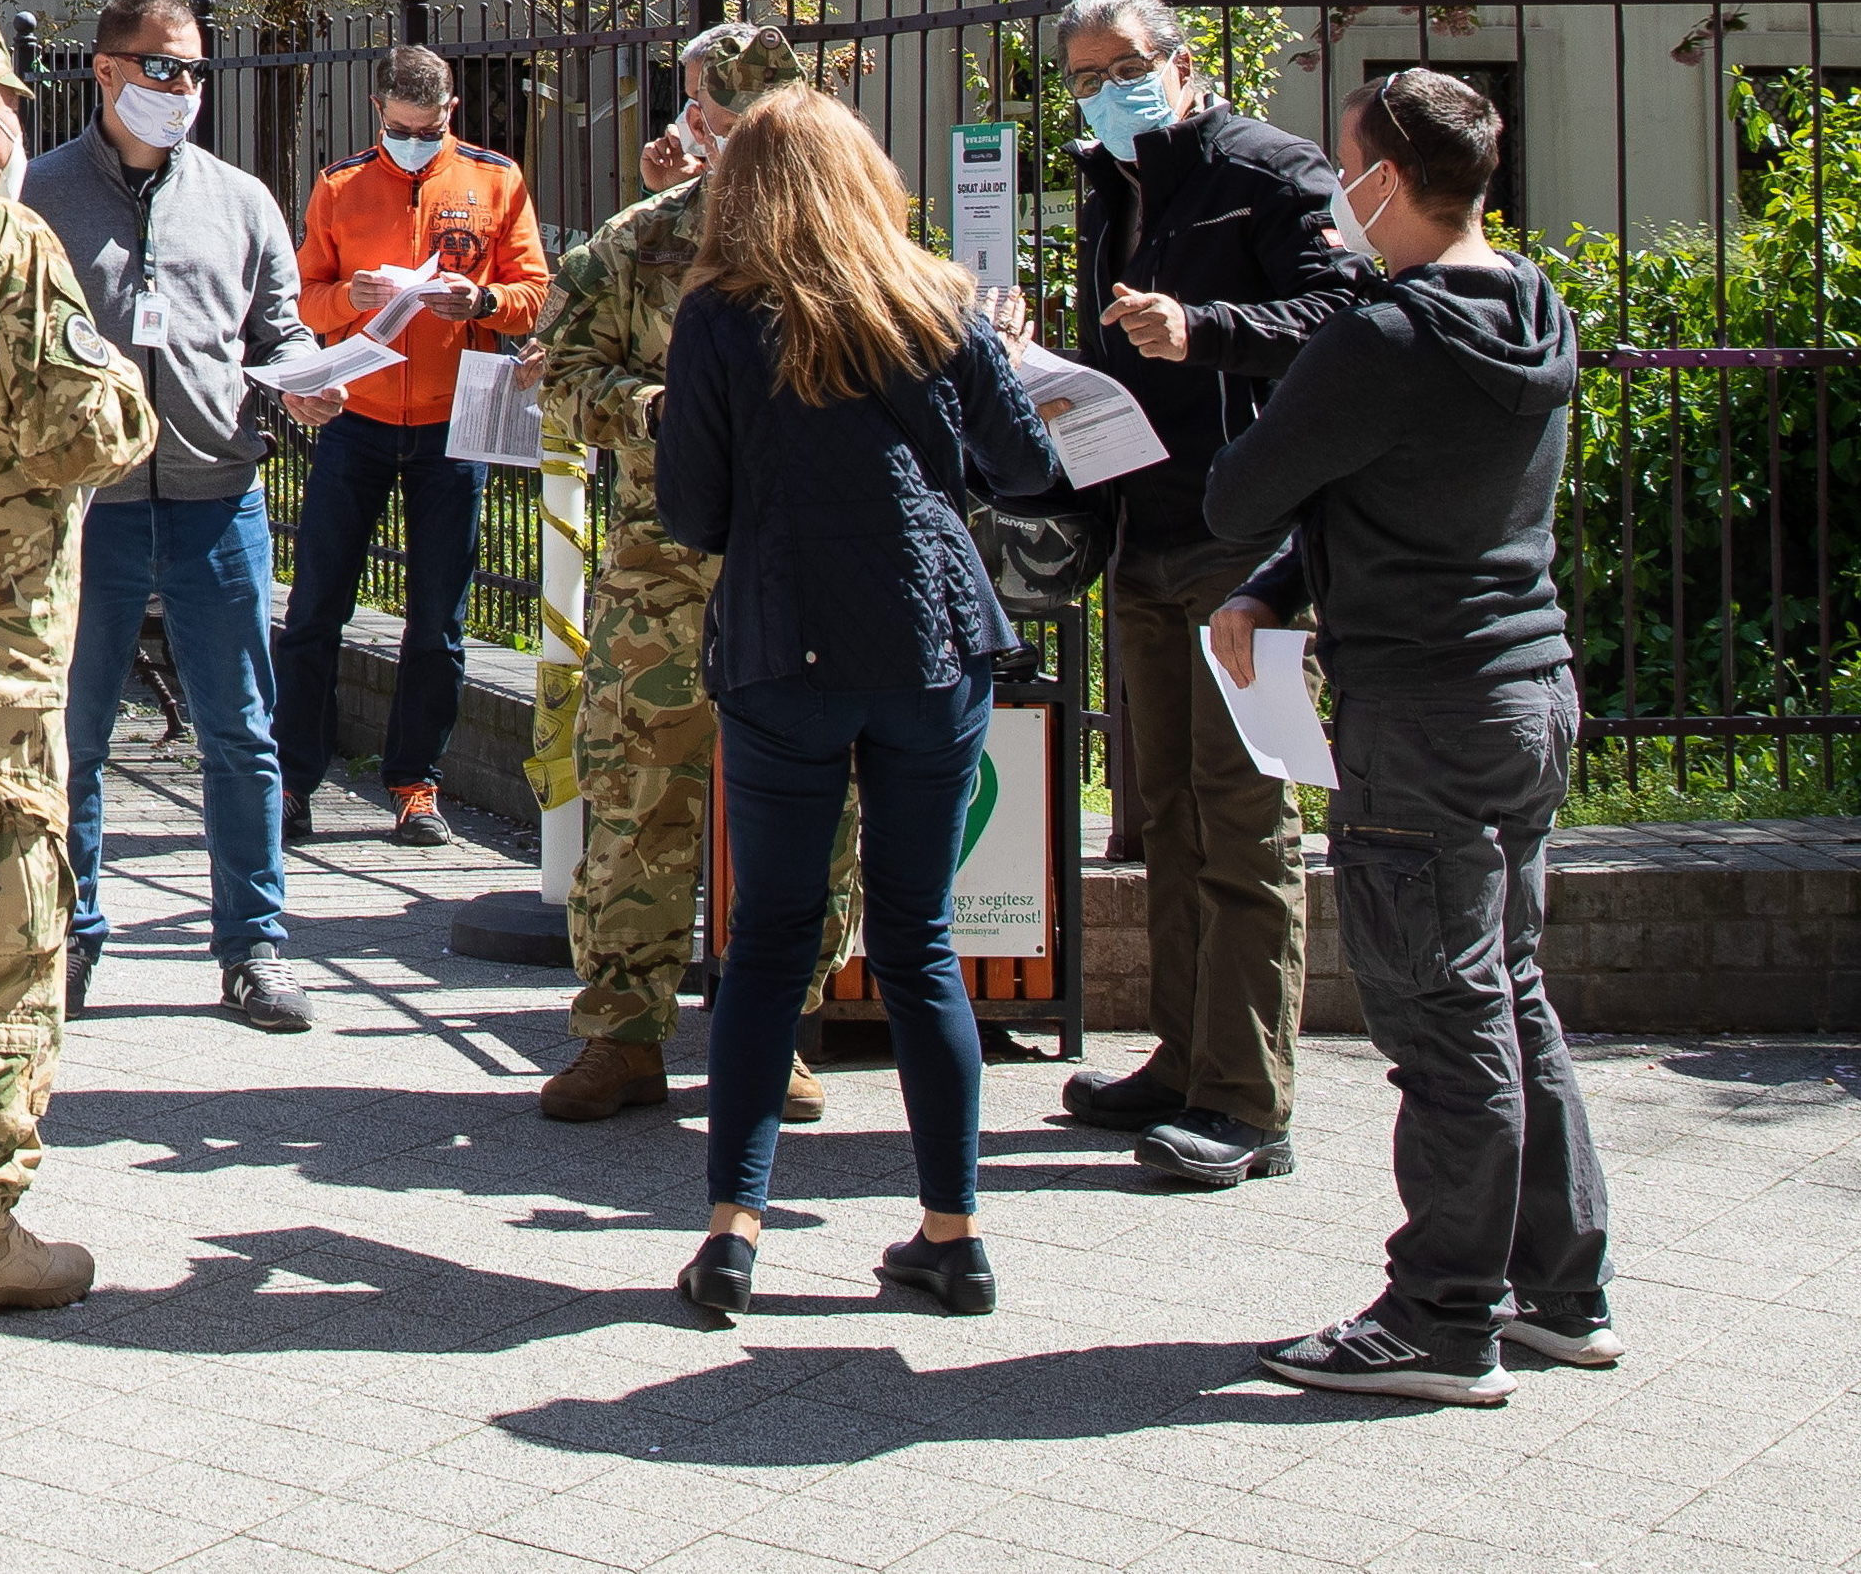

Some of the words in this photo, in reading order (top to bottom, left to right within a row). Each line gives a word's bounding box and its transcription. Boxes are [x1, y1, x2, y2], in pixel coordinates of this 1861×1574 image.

[957, 182, 978, 194] SOKAT
[980, 179, 992, 193] JÁR
[993, 181, 1007, 193] IDE?
[997, 516, 1038, 531] SHARK
[951, 895, 975, 910] ogy
[979, 892, 1035, 910] segítesz
[950, 925, 1000, 937] kormányzat
